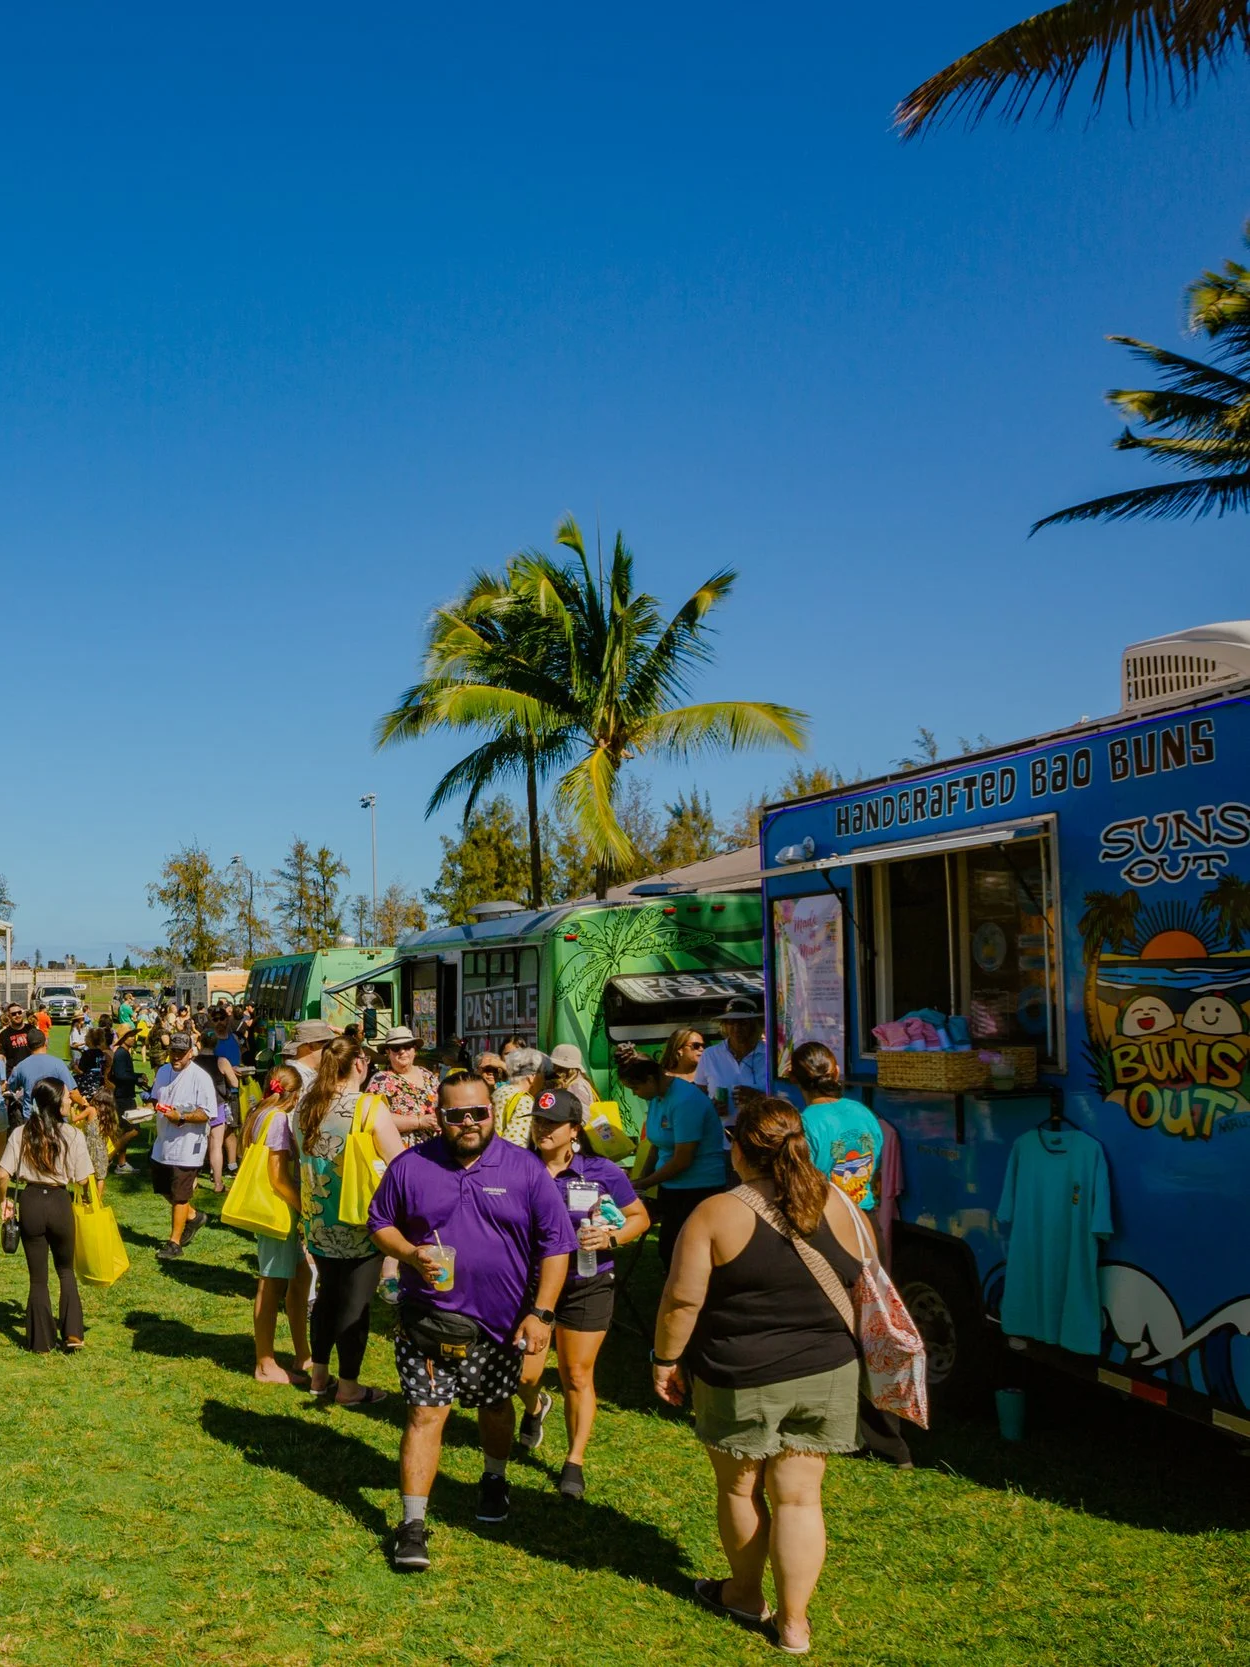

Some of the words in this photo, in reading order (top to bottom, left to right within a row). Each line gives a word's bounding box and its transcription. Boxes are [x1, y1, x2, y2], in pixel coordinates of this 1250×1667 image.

[1107, 717, 1216, 782] BUNS
[1099, 802, 1250, 863] SUNS
[1120, 851, 1229, 887] OUT
[634, 969, 765, 989] PASTEL
[464, 987, 538, 1029] PASTELE
[1111, 1038, 1247, 1088] BUNS
[1128, 1082, 1238, 1141] OUT
[1217, 1112, 1250, 1133] MAU
